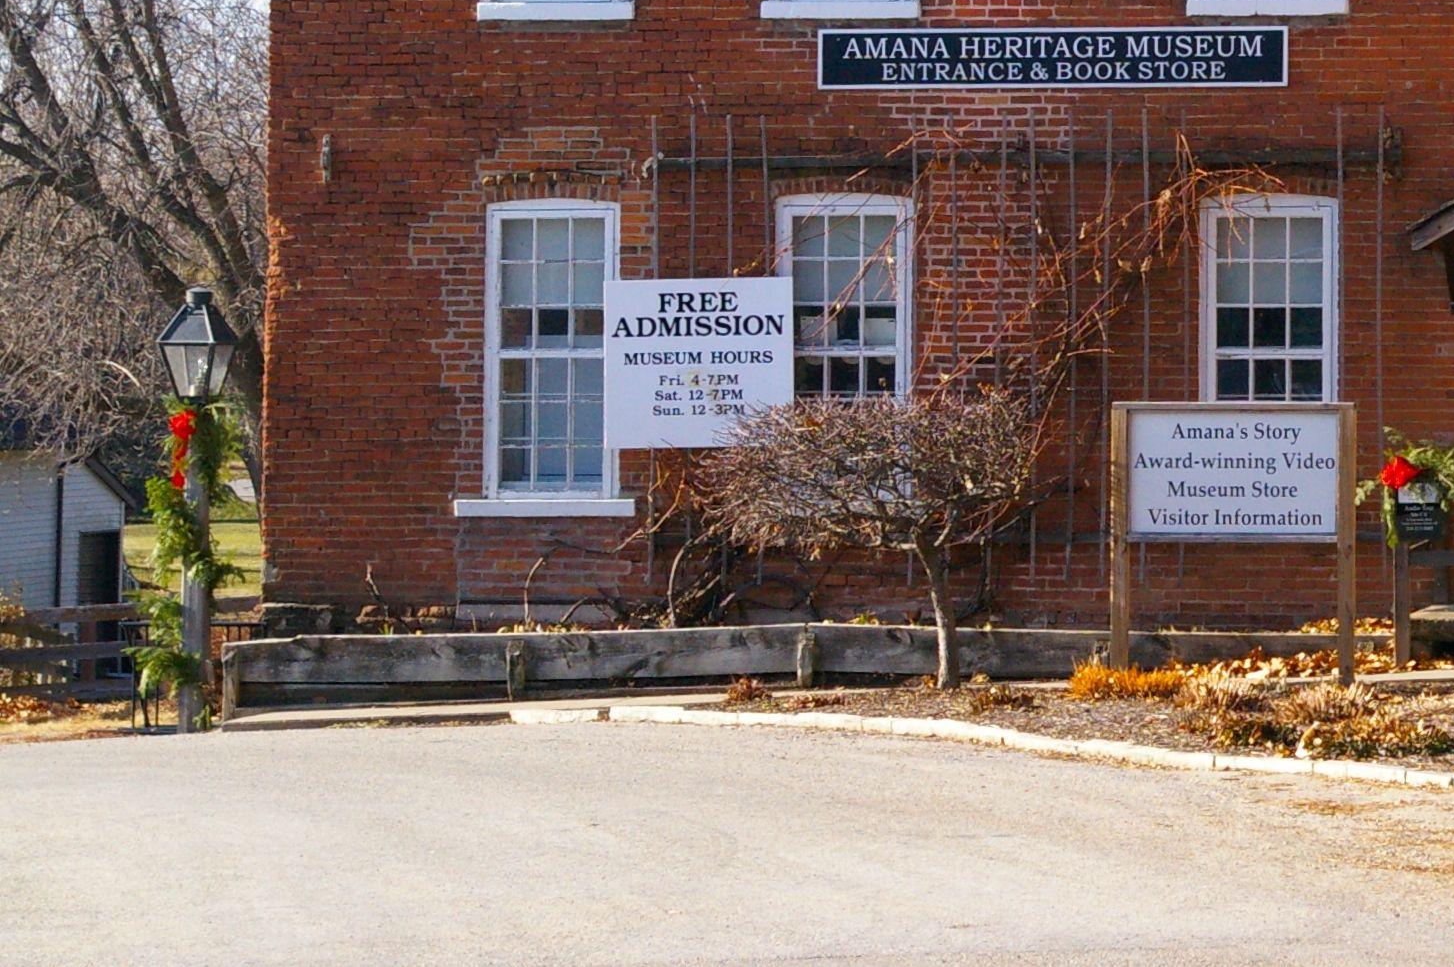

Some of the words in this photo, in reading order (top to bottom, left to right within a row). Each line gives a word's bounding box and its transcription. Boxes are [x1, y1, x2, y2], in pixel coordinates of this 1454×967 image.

[843, 37, 950, 59] AMANA
[960, 36, 1116, 58] HERITAGE
[1126, 35, 1263, 58] MUSEUM
[882, 62, 1022, 81] ENTRANCE
[1030, 62, 1049, 80] &
[1056, 62, 1130, 80] BOOK
[1138, 61, 1226, 80] STORE
[658, 291, 738, 313] FREE
[612, 315, 784, 338] ADMISSION
[624, 352, 702, 365] MUSEUM
[711, 351, 773, 364] HOURS
[659, 374, 685, 386] Fri.
[654, 389, 682, 401] Sat.
[653, 404, 685, 416] Sun.
[1171, 422, 1248, 440] Amana's
[1254, 422, 1301, 445] Story
[1134, 452, 1277, 474] Award-winning
[1282, 452, 1336, 469] Video
[1167, 481, 1245, 497] Museum
[1251, 481, 1298, 498] Store
[1147, 508, 1209, 525] Visitor
[1214, 508, 1322, 525] Information
